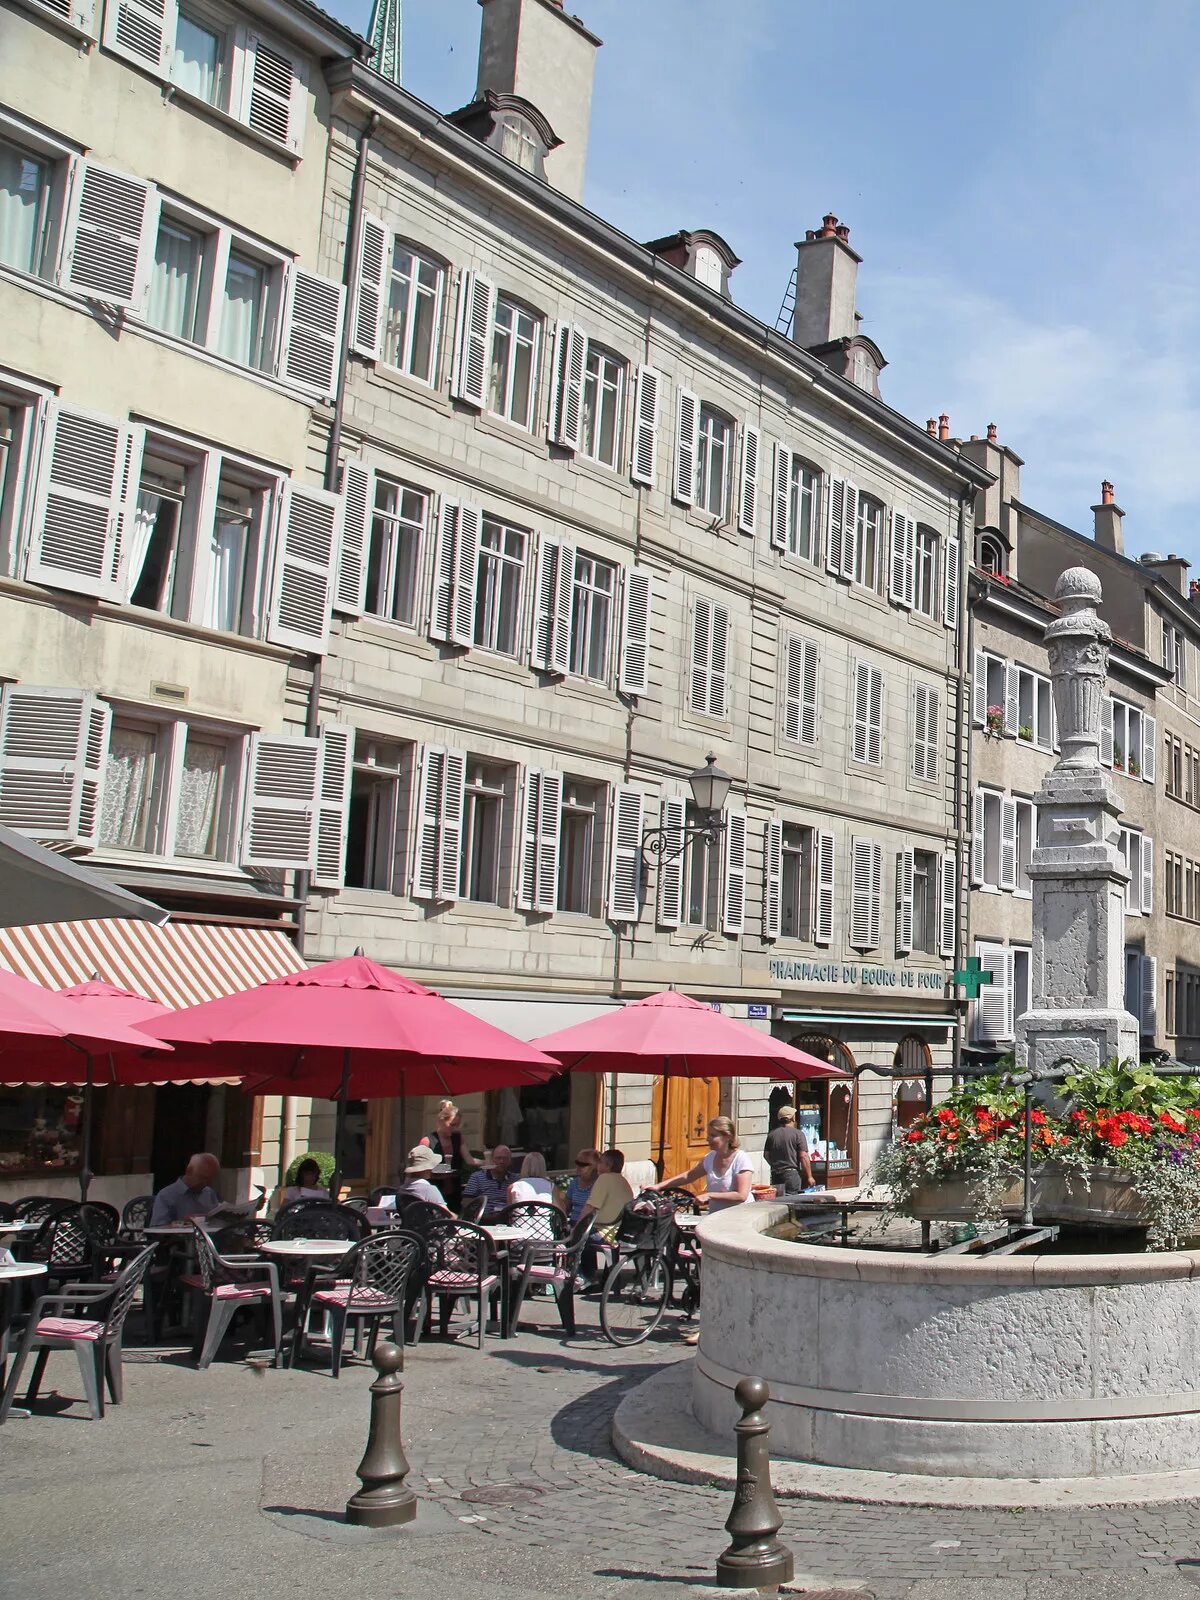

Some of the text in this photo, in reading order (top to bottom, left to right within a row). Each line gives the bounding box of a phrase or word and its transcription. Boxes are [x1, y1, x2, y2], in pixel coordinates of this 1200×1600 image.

[769, 960, 944, 990] PHARMACIE DU BOURG DE FOUR
